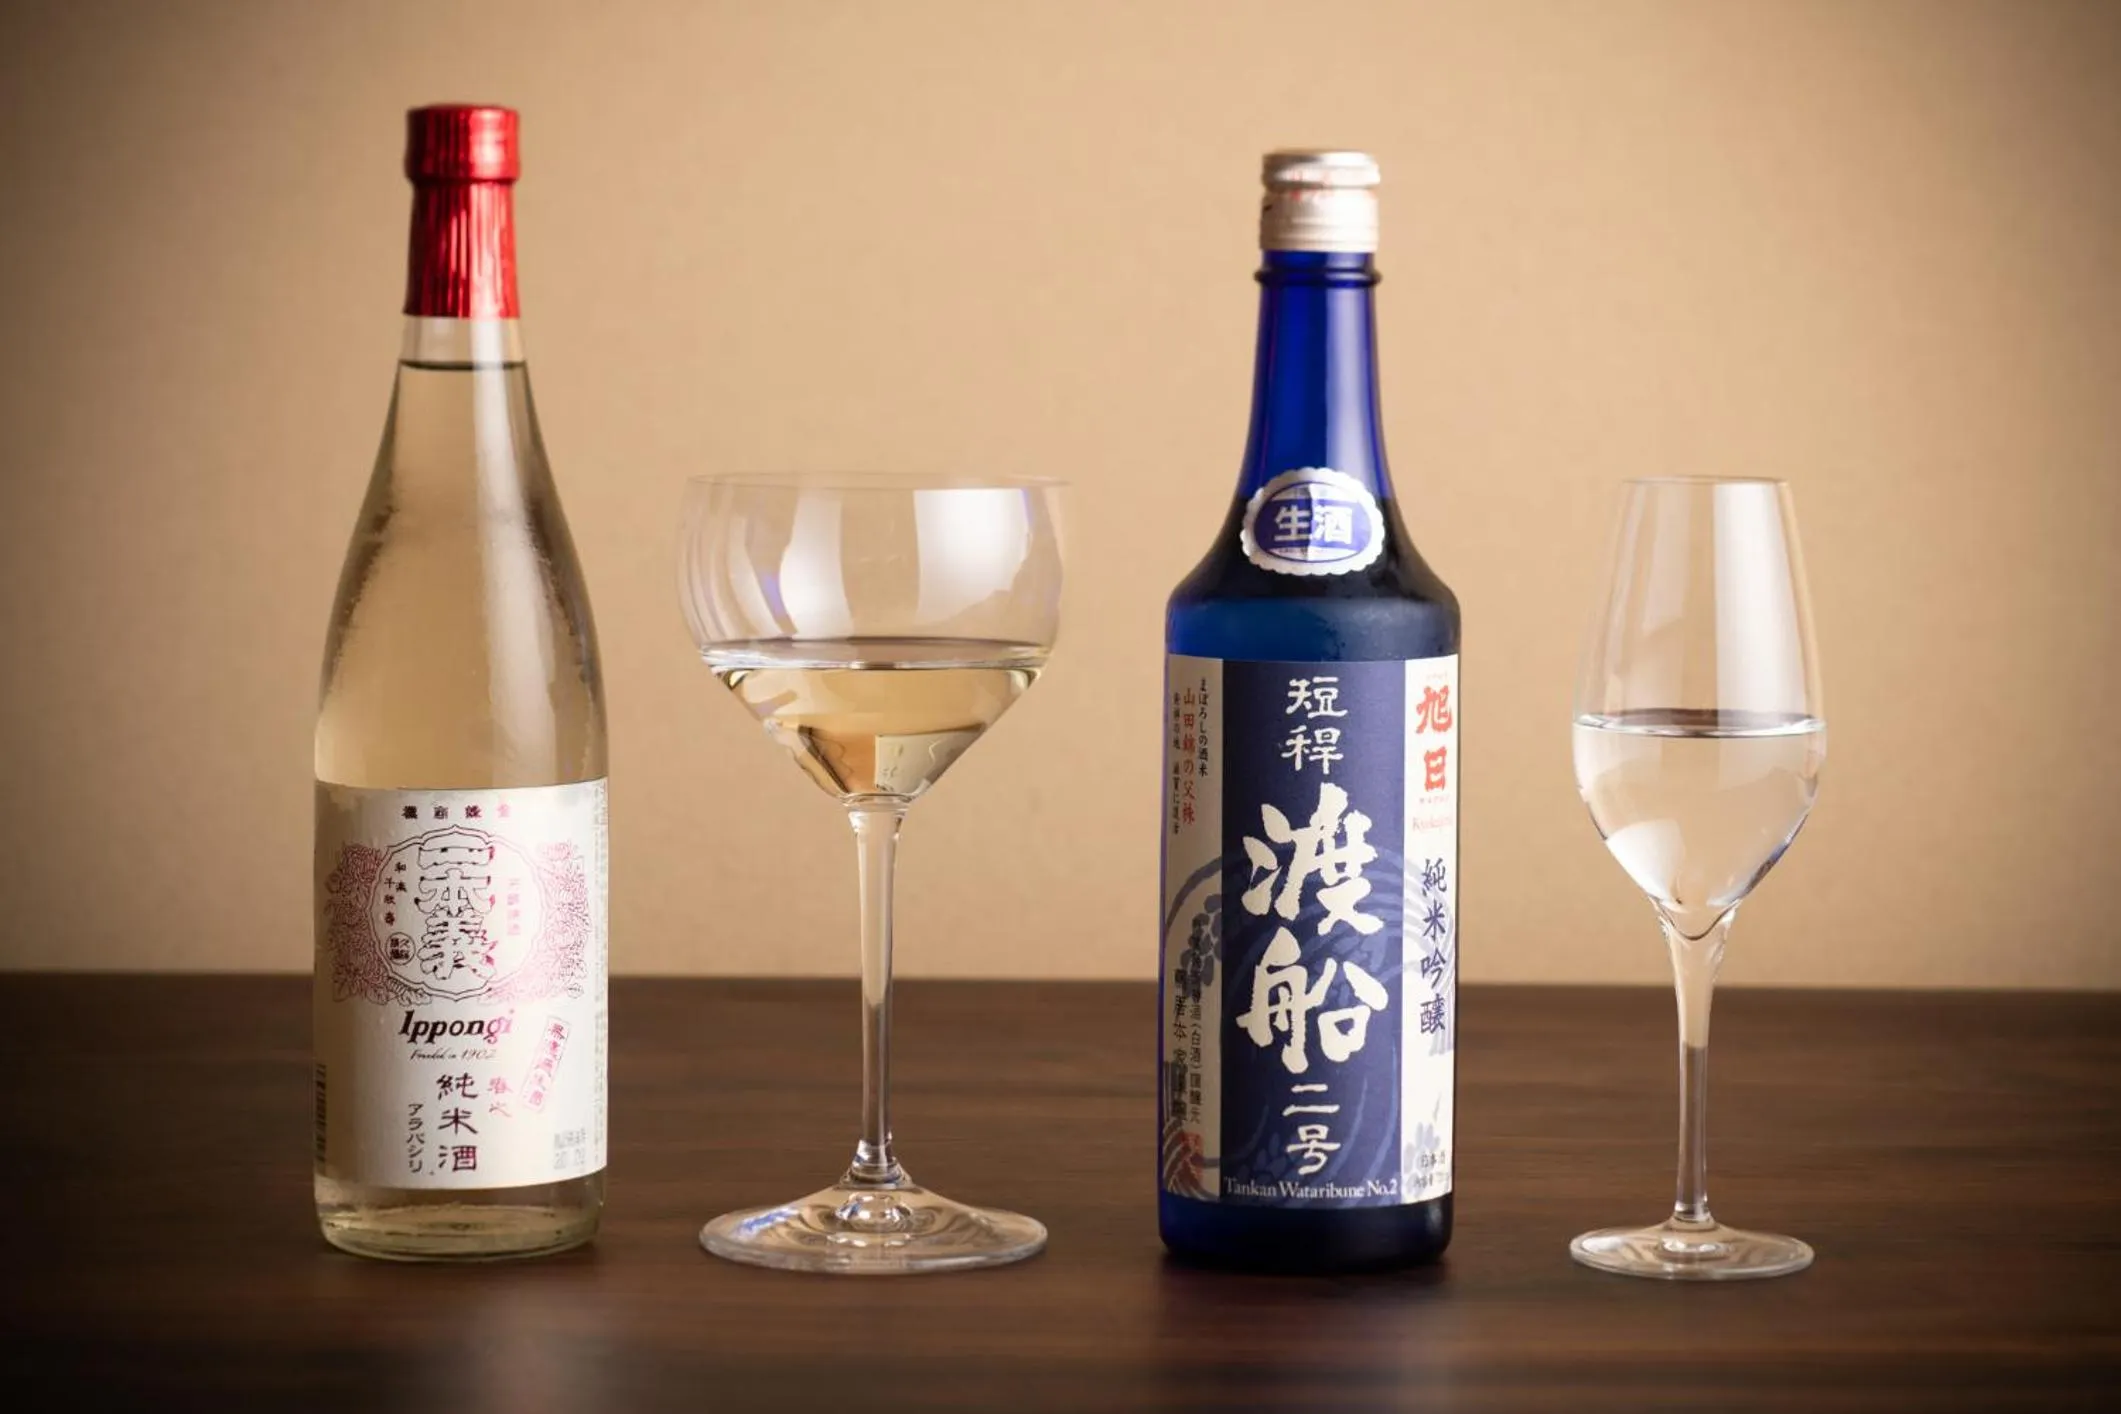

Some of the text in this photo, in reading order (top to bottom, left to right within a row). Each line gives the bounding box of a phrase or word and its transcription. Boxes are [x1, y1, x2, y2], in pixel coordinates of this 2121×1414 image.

[1274, 505, 1352, 544] 生酒
[1416, 685, 1454, 793] 旭日
[1236, 782, 1389, 1074] 渡船
[1420, 857, 1448, 1034] 純米吟醸
[399, 1009, 515, 1044] Ippongi
[407, 1103, 425, 1174] アラバシリ
[436, 1072, 479, 1173] 純米酒
[1282, 1083, 1342, 1175] 二号
[1225, 1176, 1277, 1198] Tankan
[1279, 1179, 1366, 1199] Wataribune
[1367, 1177, 1398, 1197] No.2
